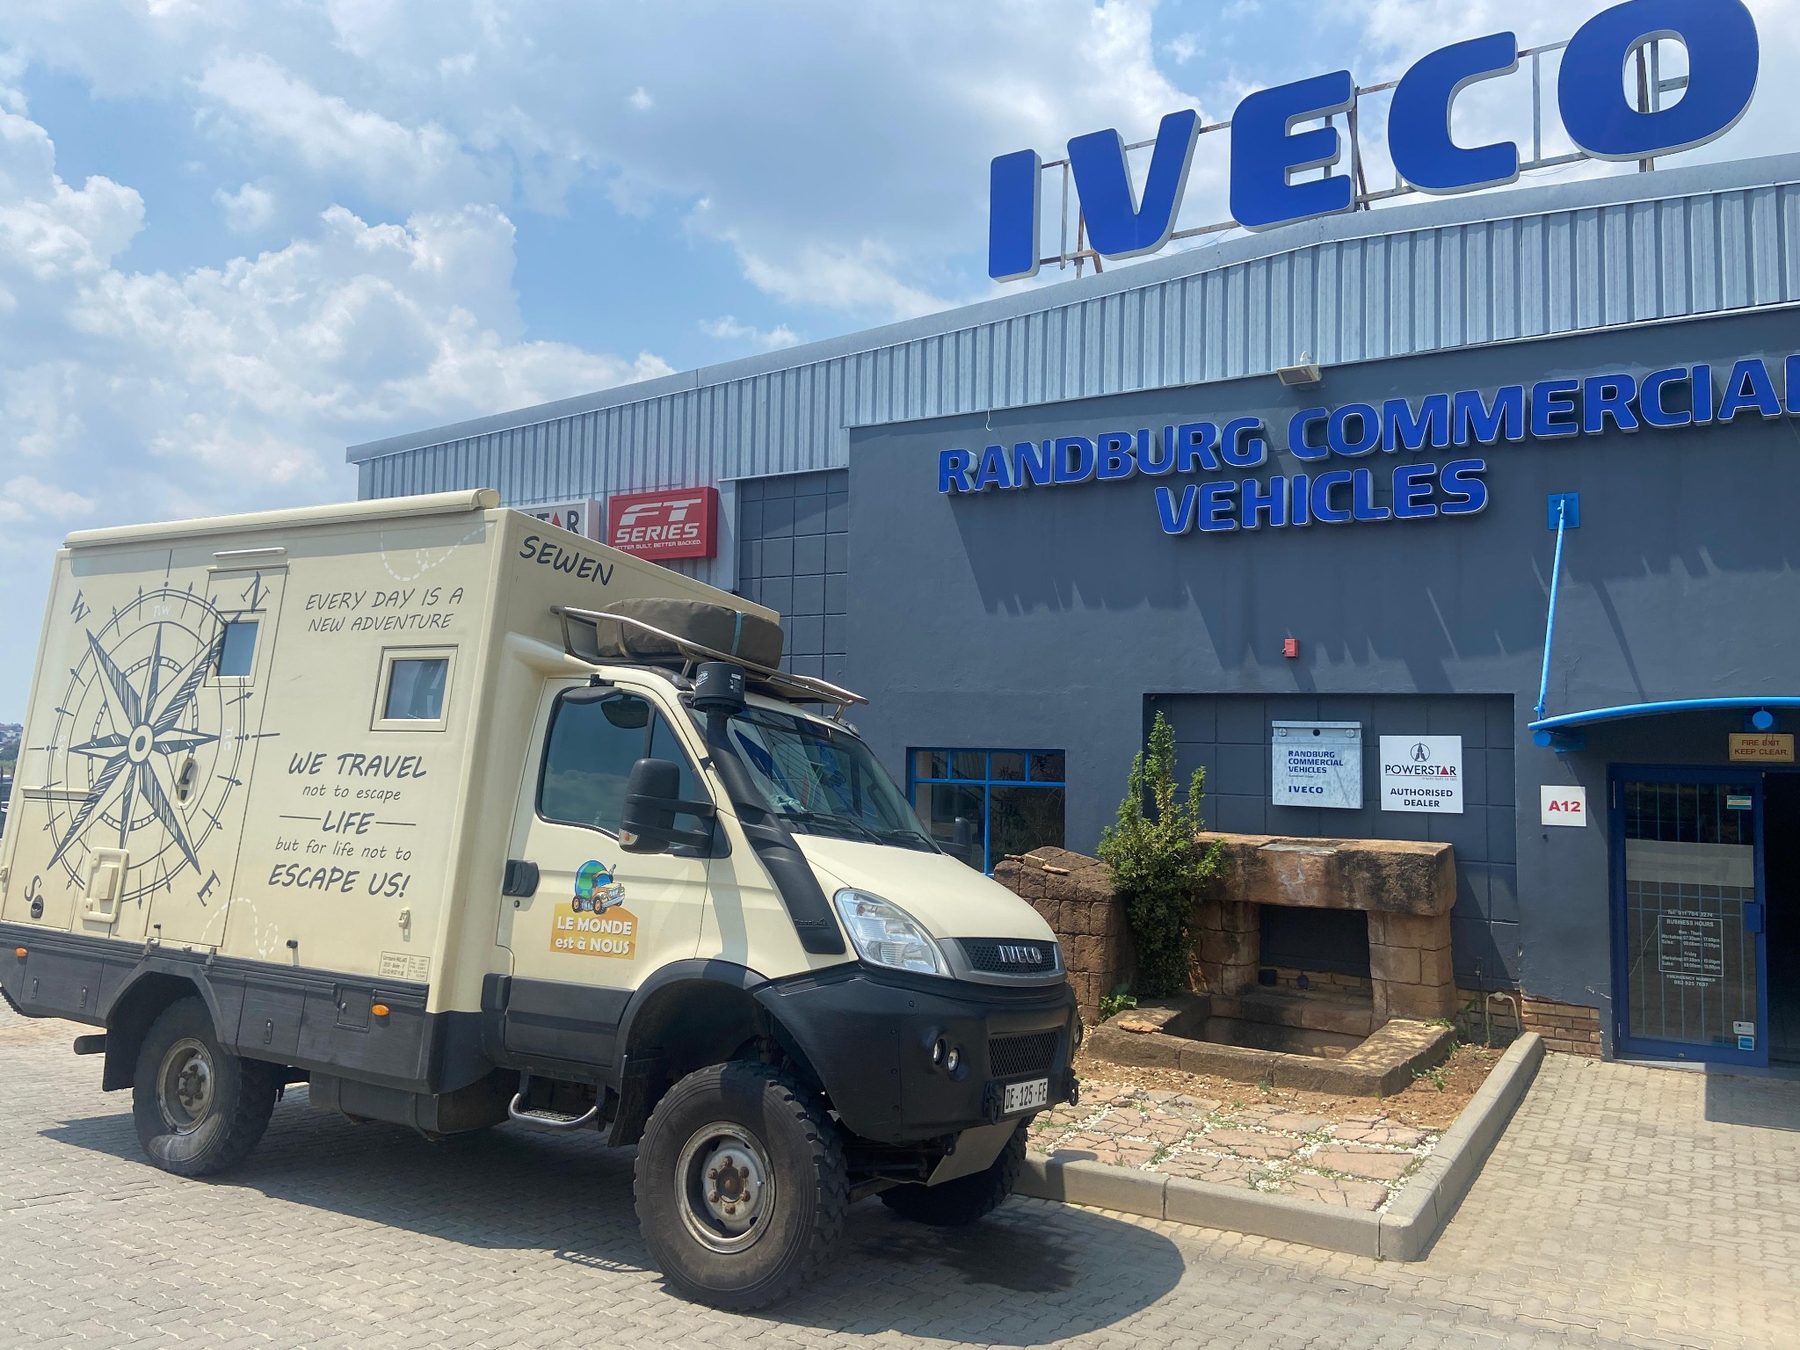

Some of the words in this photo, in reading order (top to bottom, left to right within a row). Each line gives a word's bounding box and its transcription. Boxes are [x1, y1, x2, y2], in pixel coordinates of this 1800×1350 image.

[988, 0, 1760, 282] IVECO
[938, 416, 1266, 494] RANDBURG
[1154, 458, 1489, 535] VEHICLES
[619, 498, 702, 526] FT
[615, 523, 700, 543] SERIES
[519, 535, 614, 586] SEWEN
[240, 571, 270, 614] N
[305, 590, 367, 611] EVERY
[371, 588, 416, 609] DAY
[421, 586, 442, 606] IS
[448, 587, 464, 605] A
[308, 616, 346, 632] NEW
[350, 613, 454, 631] ADVENTURE
[1734, 748, 1757, 756] KEEP
[1741, 739, 1759, 747] FIRE
[1287, 750, 1335, 759] RANDBURG
[1287, 758, 1344, 767] COMMERCIAL
[288, 752, 327, 775] WE
[337, 753, 427, 778] TRAVEL
[1287, 766, 1328, 774] VEHICLES
[1385, 764, 1457, 776] POWERSTAR
[302, 784, 326, 796] not
[334, 785, 349, 798] to
[356, 788, 401, 803] escape
[1288, 785, 1324, 794] IVECO
[1390, 788, 1453, 797] AUTHORISED
[1404, 799, 1440, 808] DEALER
[1548, 800, 1581, 812] A12
[322, 810, 375, 834] LIFE
[275, 836, 299, 851] but
[306, 839, 326, 854] for
[332, 841, 354, 857] life
[361, 846, 387, 858] not
[395, 847, 412, 861] to
[268, 863, 360, 893] ESCAPE
[368, 872, 411, 897] US!
[557, 916, 574, 930] LE
[577, 918, 632, 936] MONDE
[555, 937, 574, 949] est
[577, 936, 586, 950] à
[590, 938, 630, 955] NOUS
[998, 944, 1043, 965] IVECO
